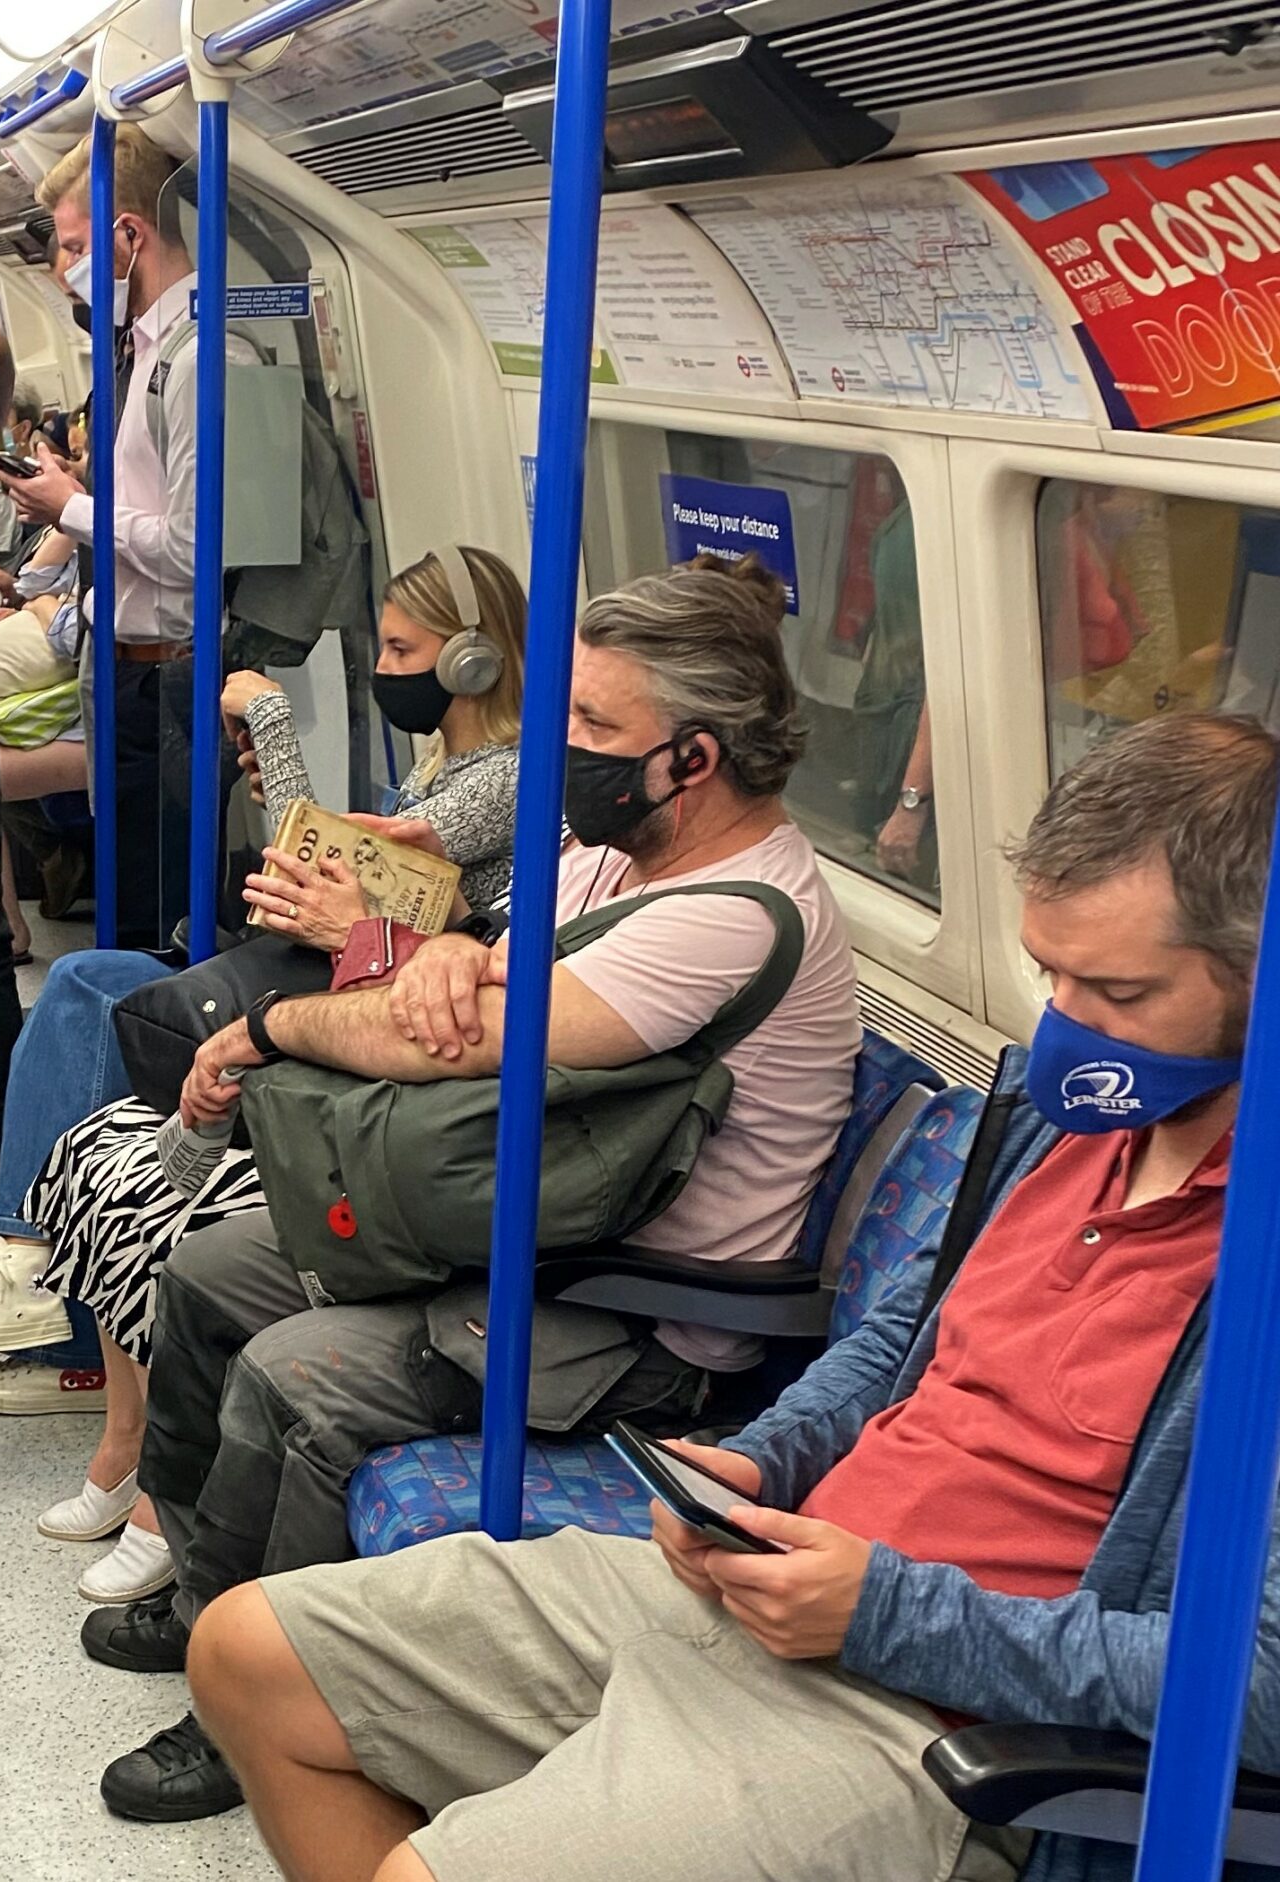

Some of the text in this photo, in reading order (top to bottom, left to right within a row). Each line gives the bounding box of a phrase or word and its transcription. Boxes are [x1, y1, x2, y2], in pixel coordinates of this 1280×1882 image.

[1045, 237, 1092, 266] STAND
[1064, 260, 1111, 290] CLEAR
[1081, 291, 1104, 316] OF
[673, 503, 780, 540] Please keep your distance
[297, 828, 318, 863] OD
[407, 887, 426, 930] RGERY
[1063, 1095, 1143, 1110] LEINSTER
